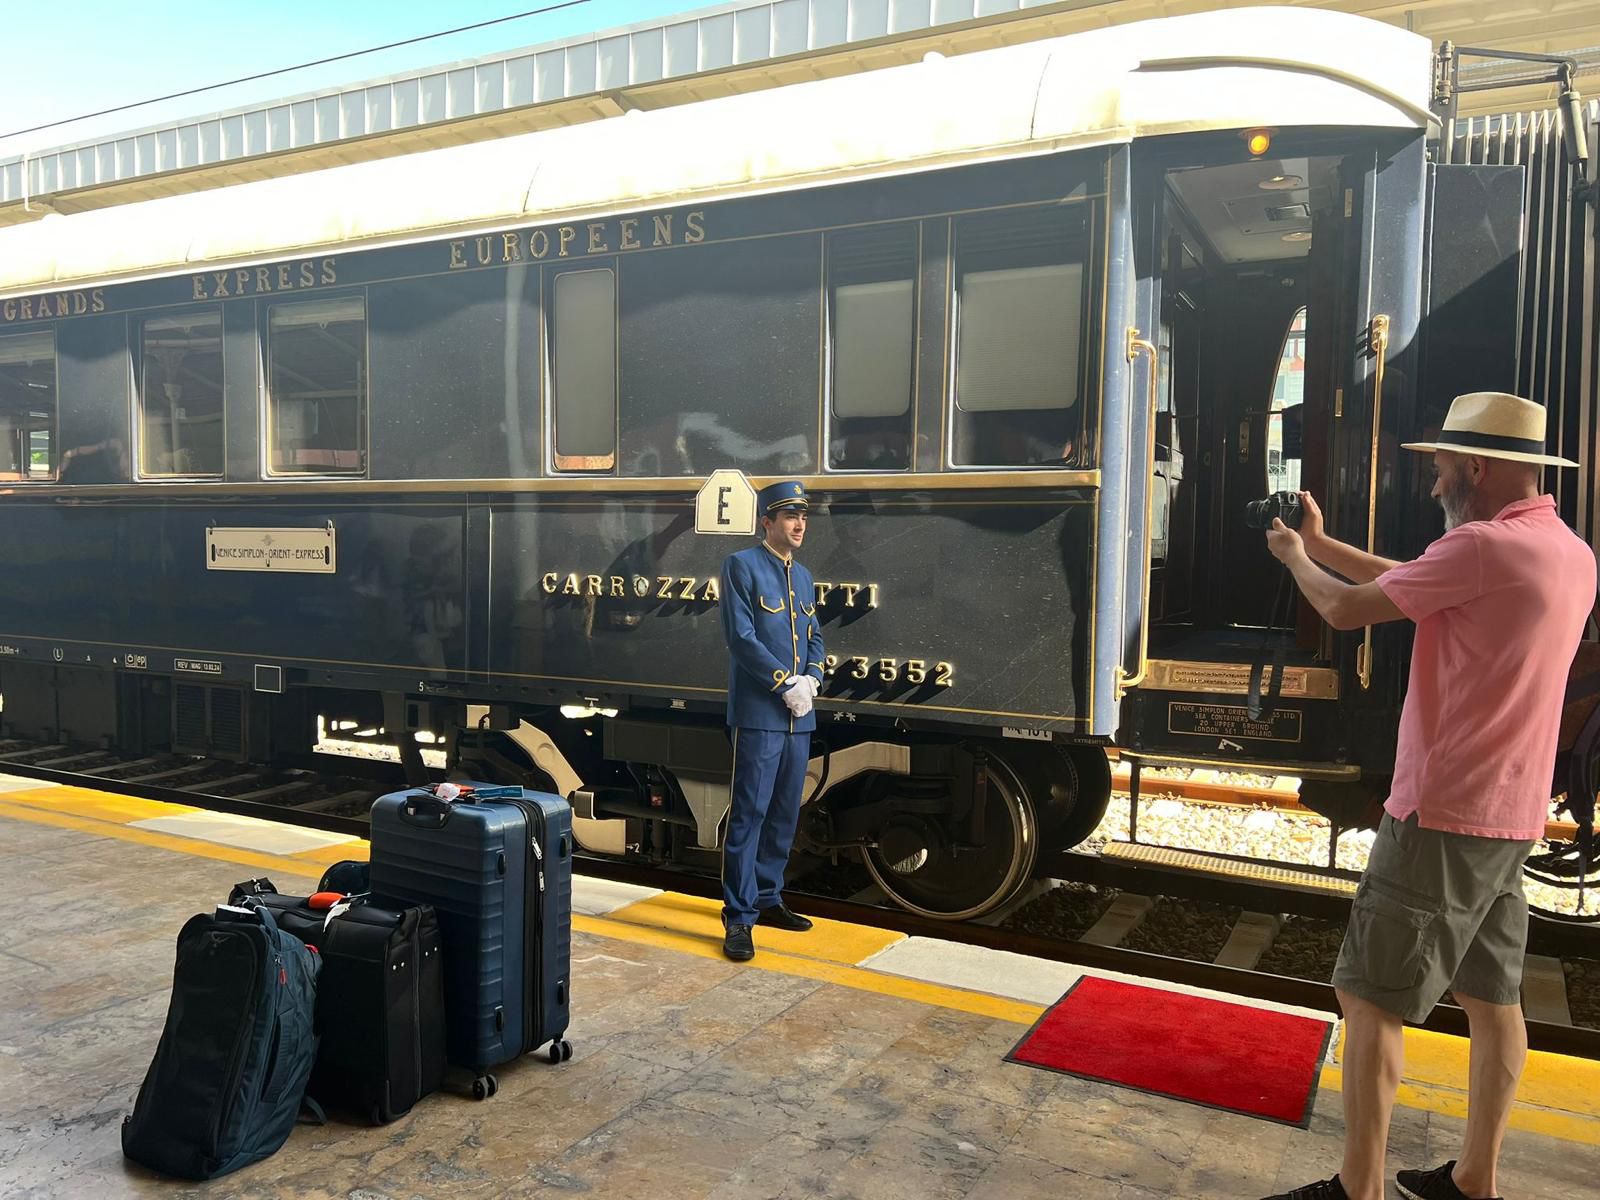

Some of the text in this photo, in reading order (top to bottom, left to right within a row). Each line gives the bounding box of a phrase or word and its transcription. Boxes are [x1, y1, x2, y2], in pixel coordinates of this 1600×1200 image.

[3, 211, 705, 322] GRANDS EXPRESS EUROPEENS
[717, 486, 732, 525] E
[215, 548, 237, 558] VENICE
[542, 570, 720, 601] CARROZZA
[177, 661, 188, 669] REV
[851, 656, 953, 687] 3552
[1174, 704, 1195, 713] VENICE
[1199, 706, 1225, 715] SIMPLON
[1228, 708, 1248, 716] ORIEN
[1194, 712, 1206, 720] SEA
[1210, 713, 1248, 723] CONTAINERS
[1194, 725, 1219, 734] LONDON
[1224, 727, 1237, 735] SE1
[1214, 721, 1235, 729] UPPER
[1242, 722, 1270, 731] GROUND
